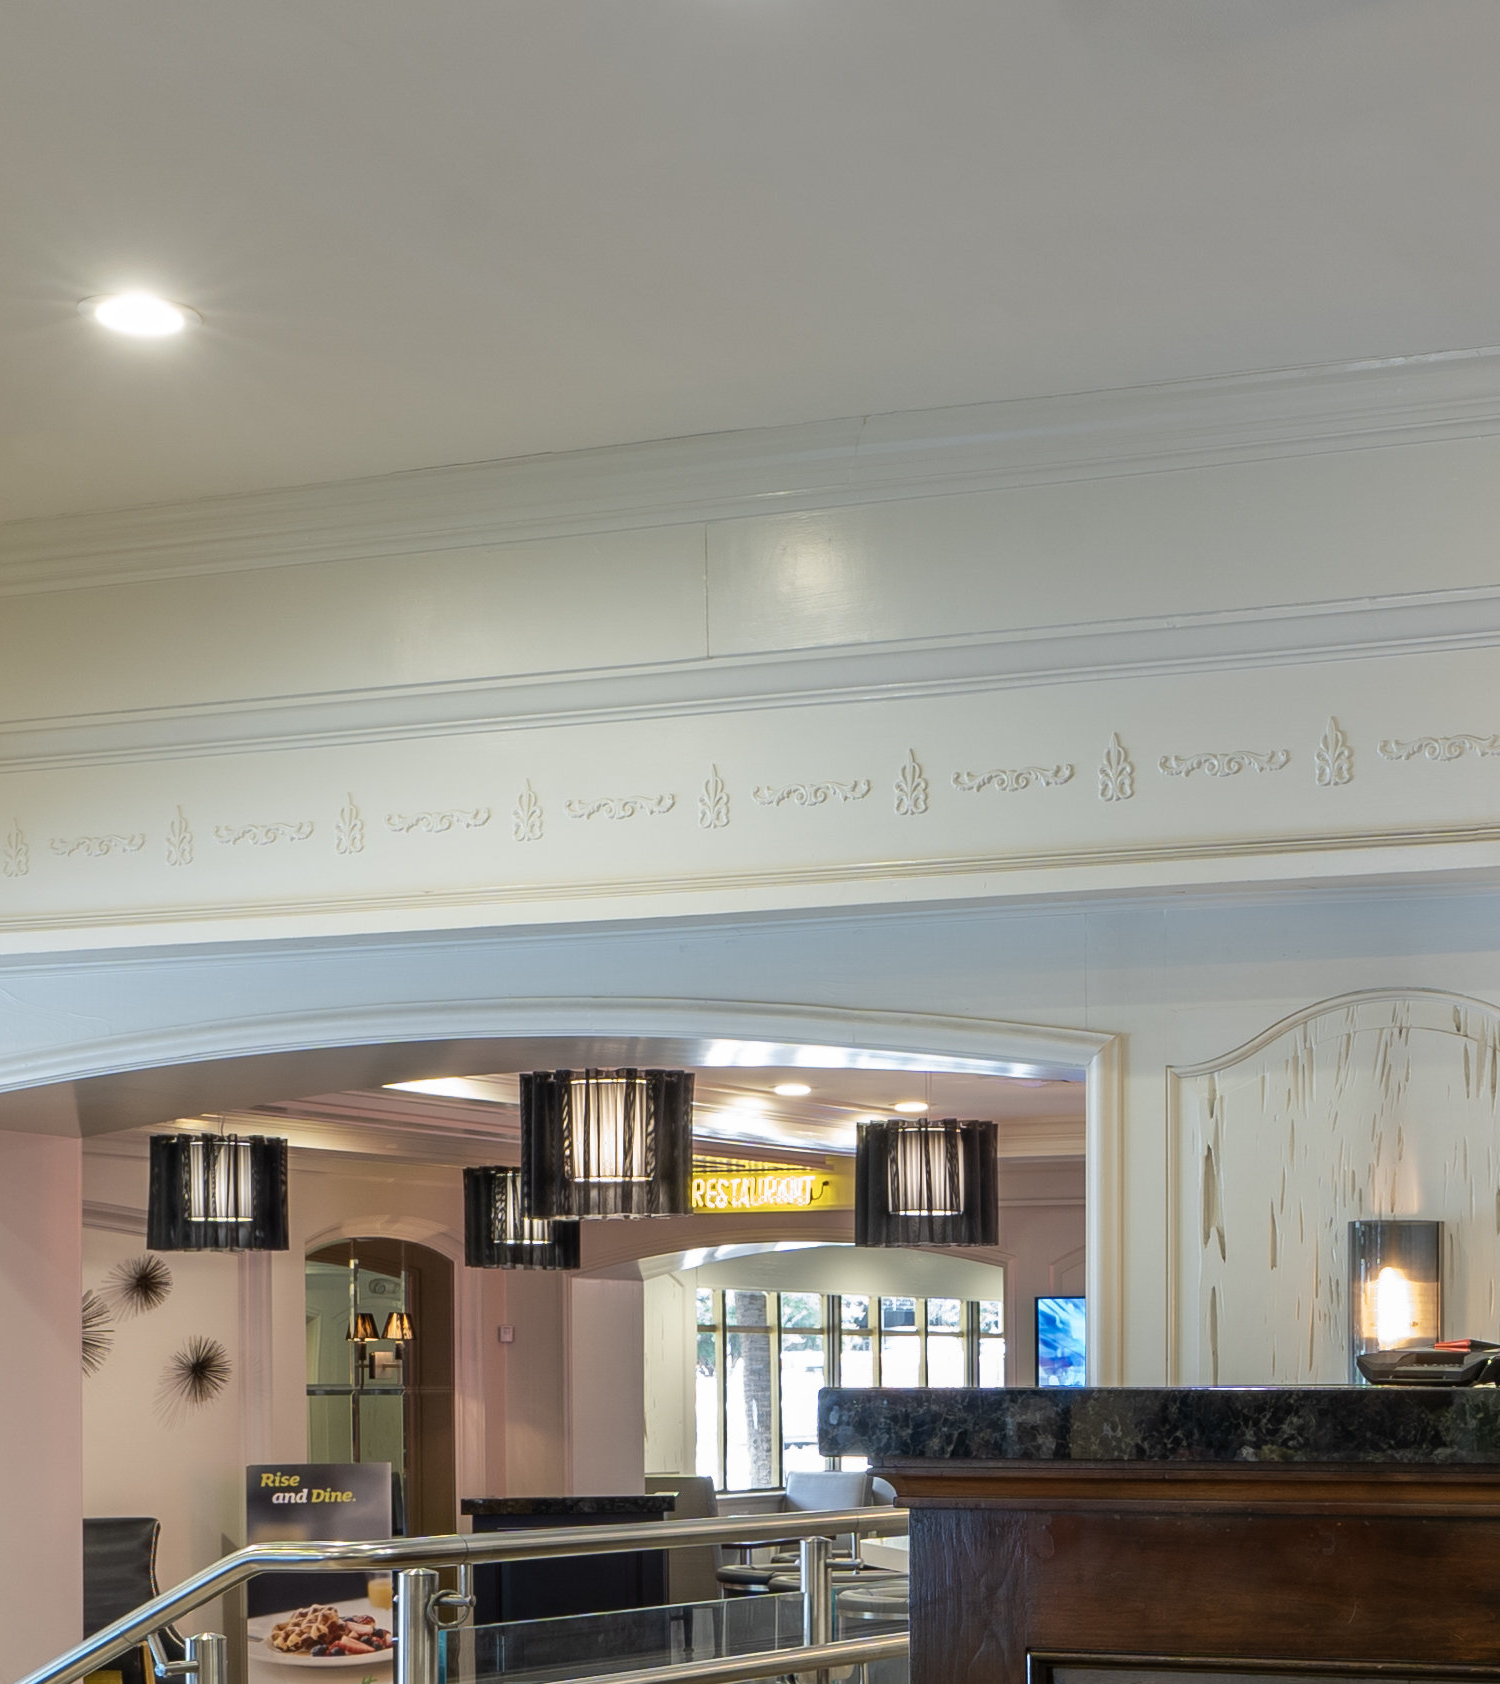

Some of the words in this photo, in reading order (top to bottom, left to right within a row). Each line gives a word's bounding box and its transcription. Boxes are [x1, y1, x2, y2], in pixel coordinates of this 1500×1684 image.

[691, 1175, 817, 1209] RESTAURANT
[260, 1471, 301, 1488] Rise
[271, 1488, 309, 1504] and
[311, 1487, 357, 1504] Dine.
